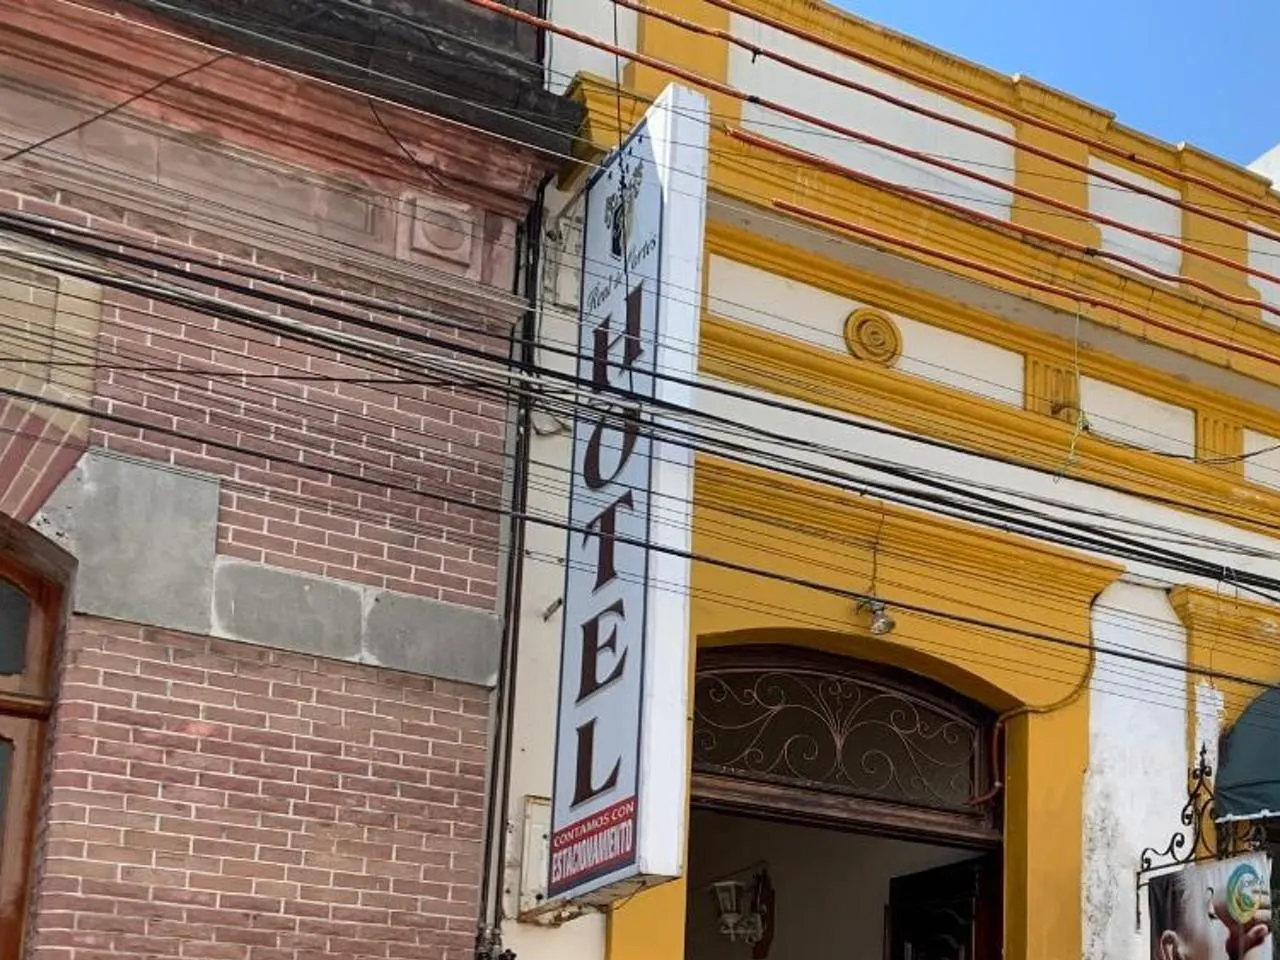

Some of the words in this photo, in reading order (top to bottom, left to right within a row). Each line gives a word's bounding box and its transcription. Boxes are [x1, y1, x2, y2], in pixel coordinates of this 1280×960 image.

[570, 279, 644, 809] HOTEL
[552, 819, 633, 883] ESTACIONAMIENTO
[554, 812, 610, 848] CONTAMOS
[611, 801, 634, 821] CON
